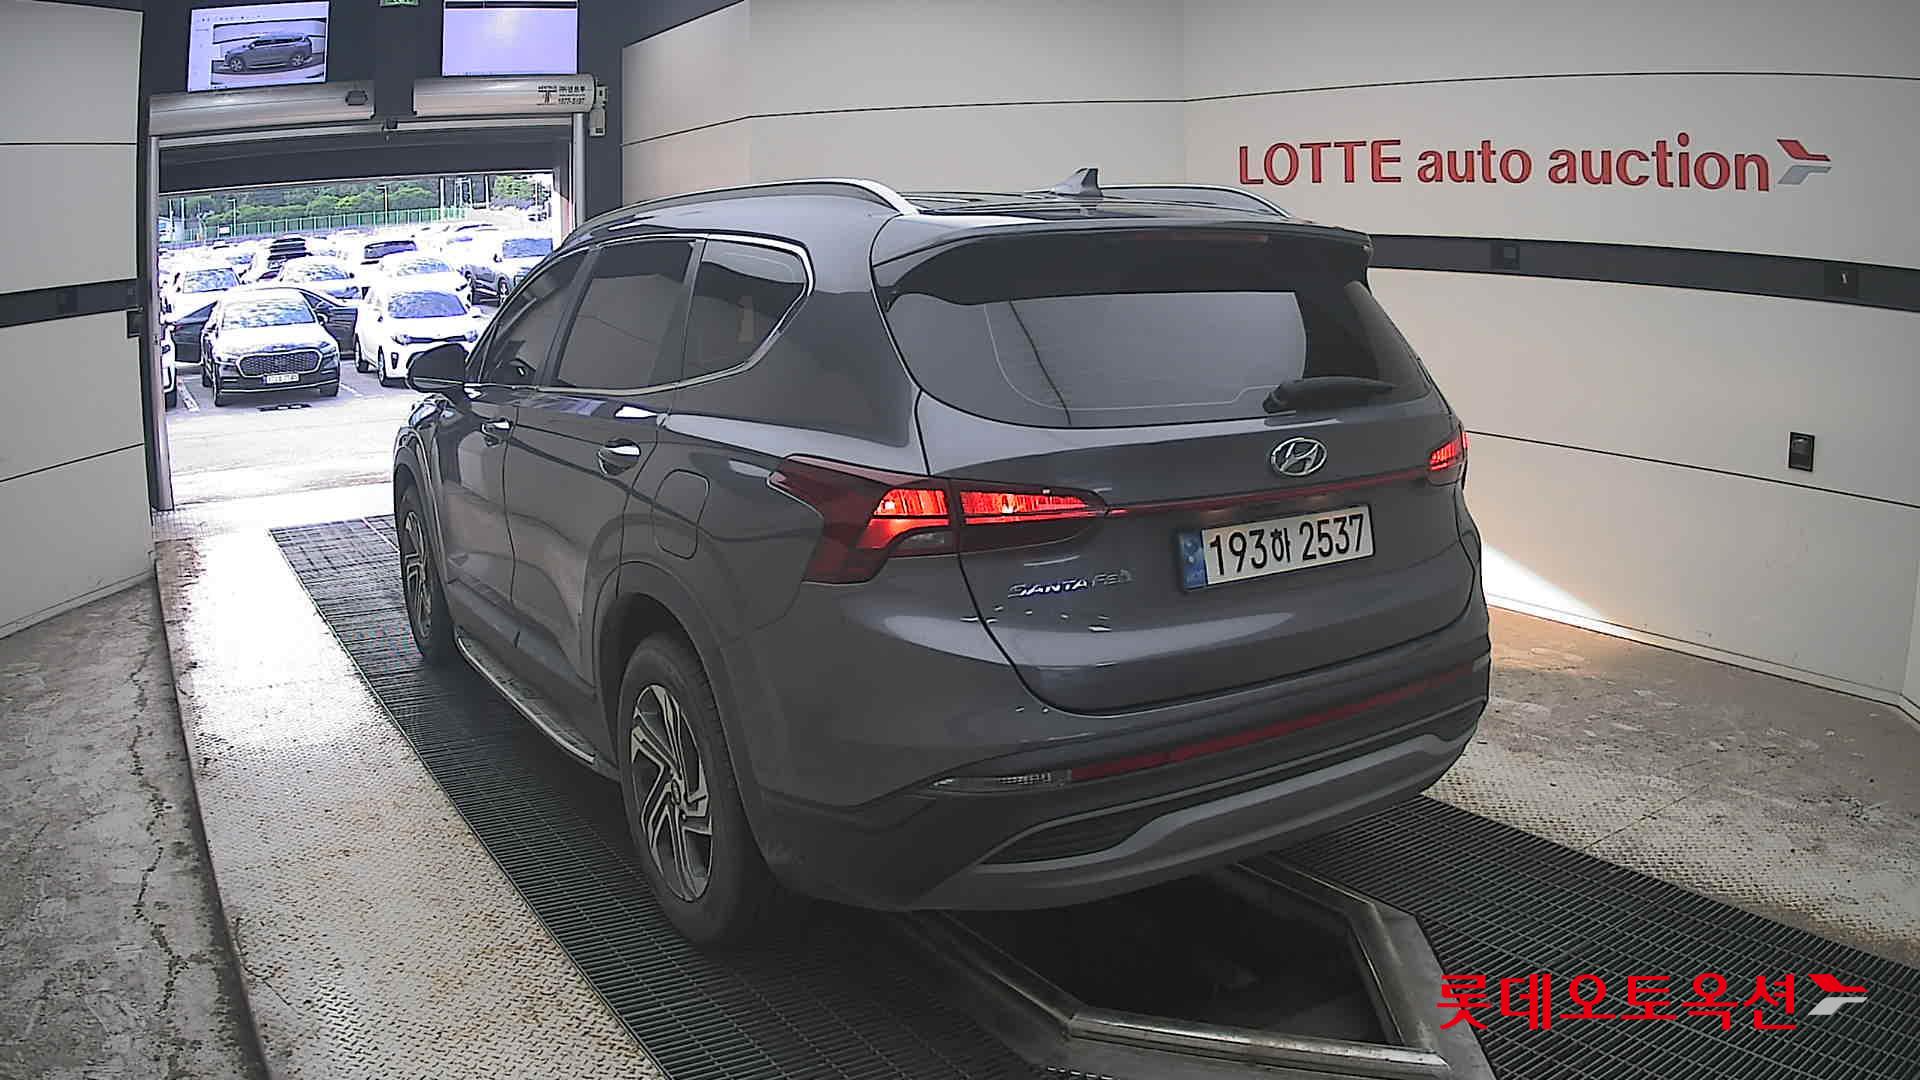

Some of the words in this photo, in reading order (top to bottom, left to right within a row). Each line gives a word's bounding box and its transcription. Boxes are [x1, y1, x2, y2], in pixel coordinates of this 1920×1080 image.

[1238, 139, 1402, 186] LOTTE
[1416, 139, 1533, 185] auto
[1547, 131, 1771, 192] auction
[1209, 527, 1291, 576] 193하
[1299, 513, 1365, 562] 2537
[1006, 577, 1089, 600] SANTA
